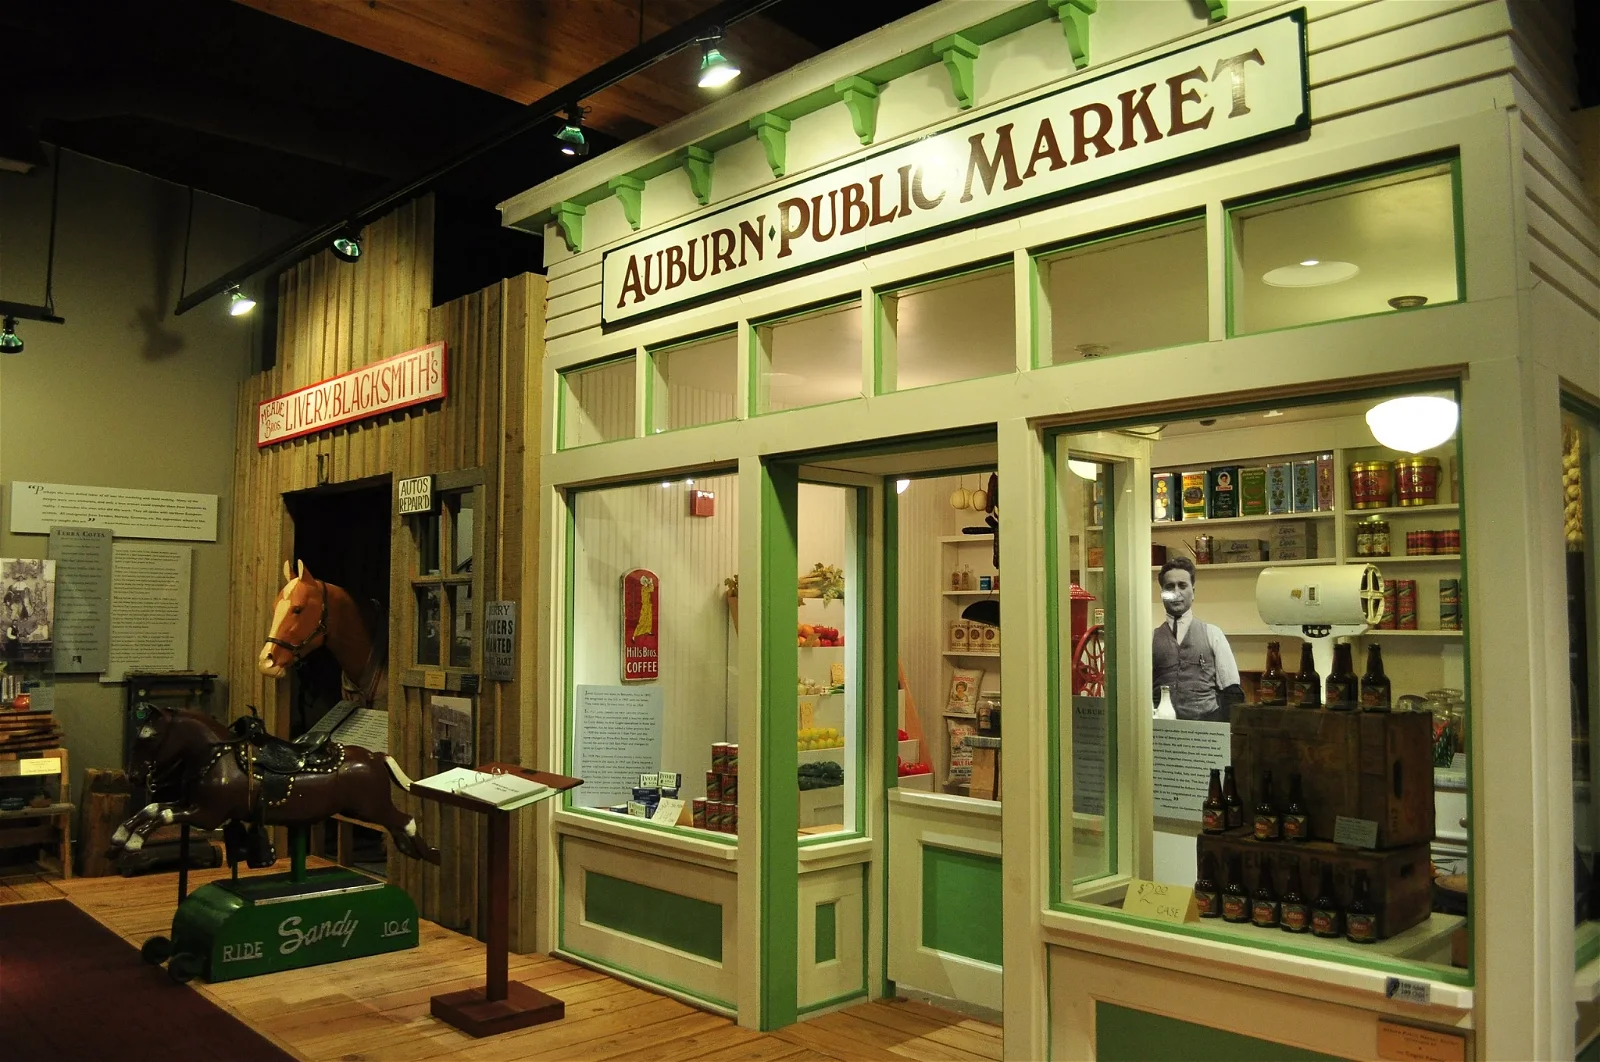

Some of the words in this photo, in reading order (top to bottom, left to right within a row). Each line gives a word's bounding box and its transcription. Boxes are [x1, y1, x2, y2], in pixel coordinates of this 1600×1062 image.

[617, 214, 766, 309] AUBURN
[777, 163, 947, 259] PUBLIC
[960, 48, 1265, 203] MARKET
[261, 401, 285, 424] MEADE
[401, 477, 429, 496] AUTOS
[399, 494, 430, 512] REPAIR'D
[626, 646, 642, 658] Hills
[626, 661, 657, 674] COFFEE
[1156, 904, 1180, 918] CASE
[277, 909, 360, 955] Sandy
[222, 941, 264, 962] RIDE
